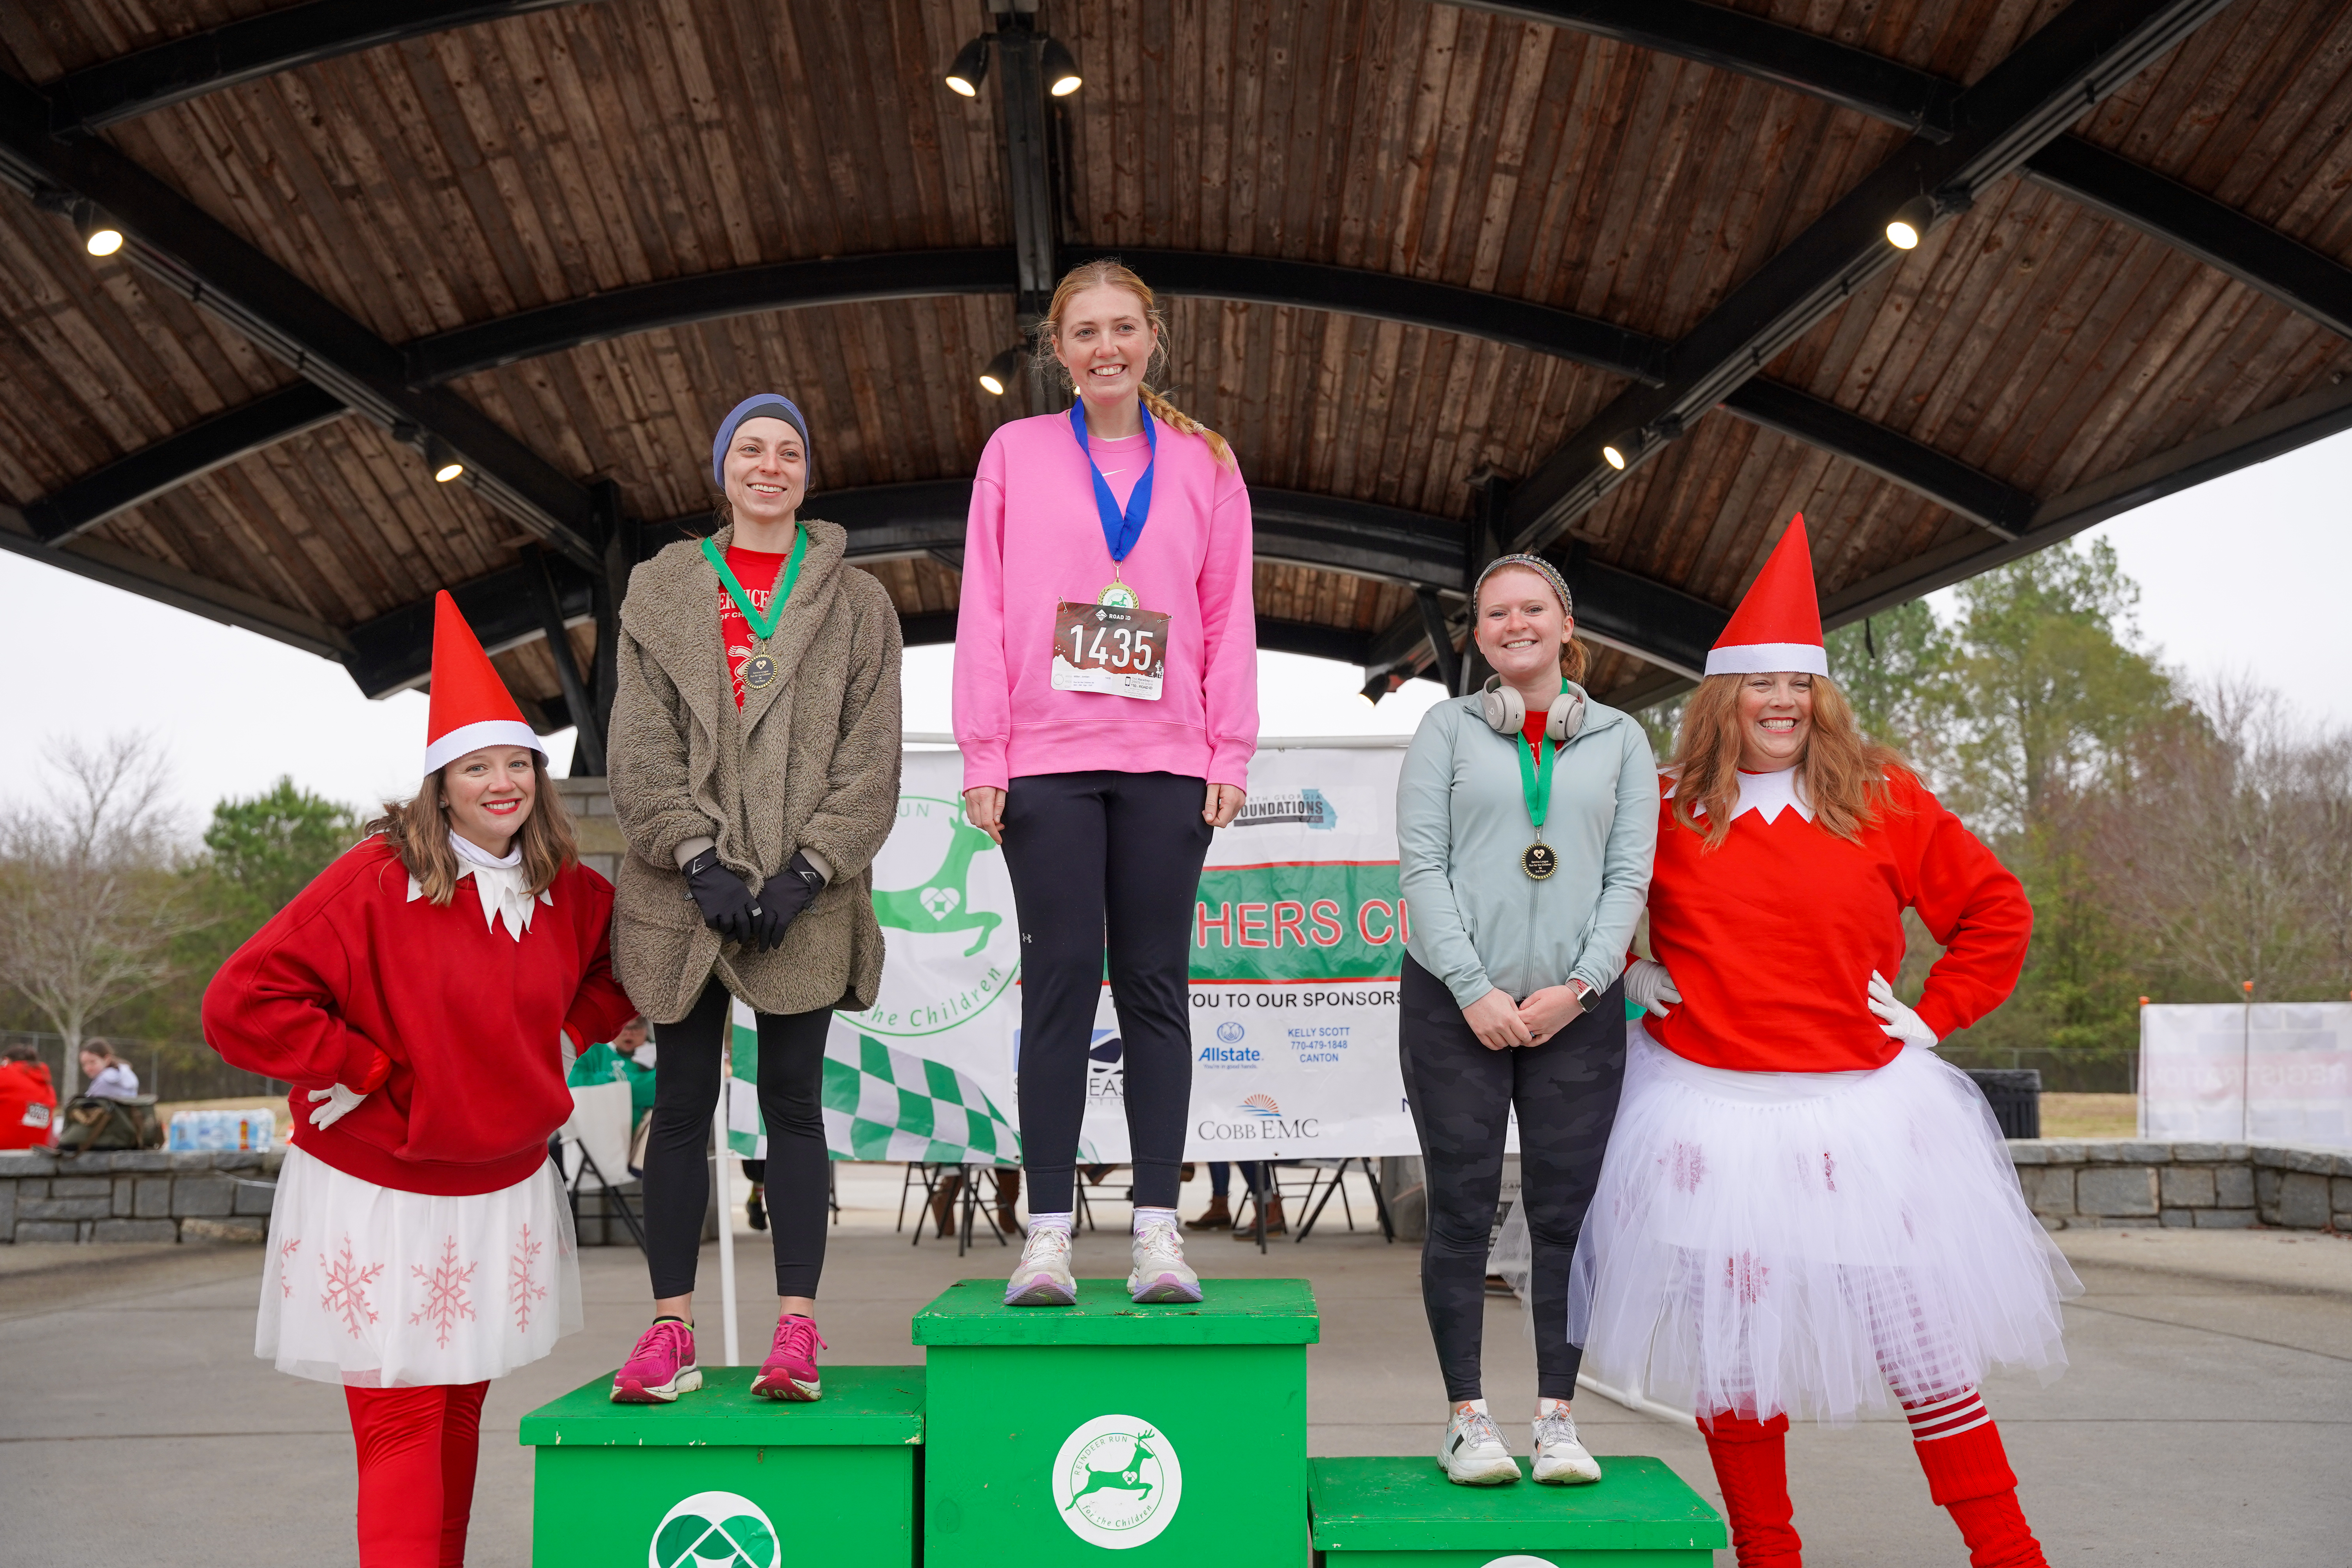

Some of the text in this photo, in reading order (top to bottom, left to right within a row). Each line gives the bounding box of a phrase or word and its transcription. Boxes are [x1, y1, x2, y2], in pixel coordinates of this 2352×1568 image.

[1070, 624, 1154, 671] 1435
[898, 803, 929, 817] UN
[1240, 801, 1323, 817] OUNDATIONS
[1192, 898, 1343, 949] HERS
[910, 966, 1001, 1027] Children
[1188, 993, 1219, 1008] OU
[1226, 993, 1250, 1008] TO
[1257, 993, 1297, 1008] OUR
[1288, 1027, 1350, 1037] KELLY SCOTT
[1290, 1040, 1347, 1050] 770-479-1848
[1299, 1053, 1339, 1063] CANTON
[1261, 1118, 1319, 1140] EMC
[1074, 1439, 1105, 1475] REINDEER
[1082, 1505, 1152, 1527] for the Children
